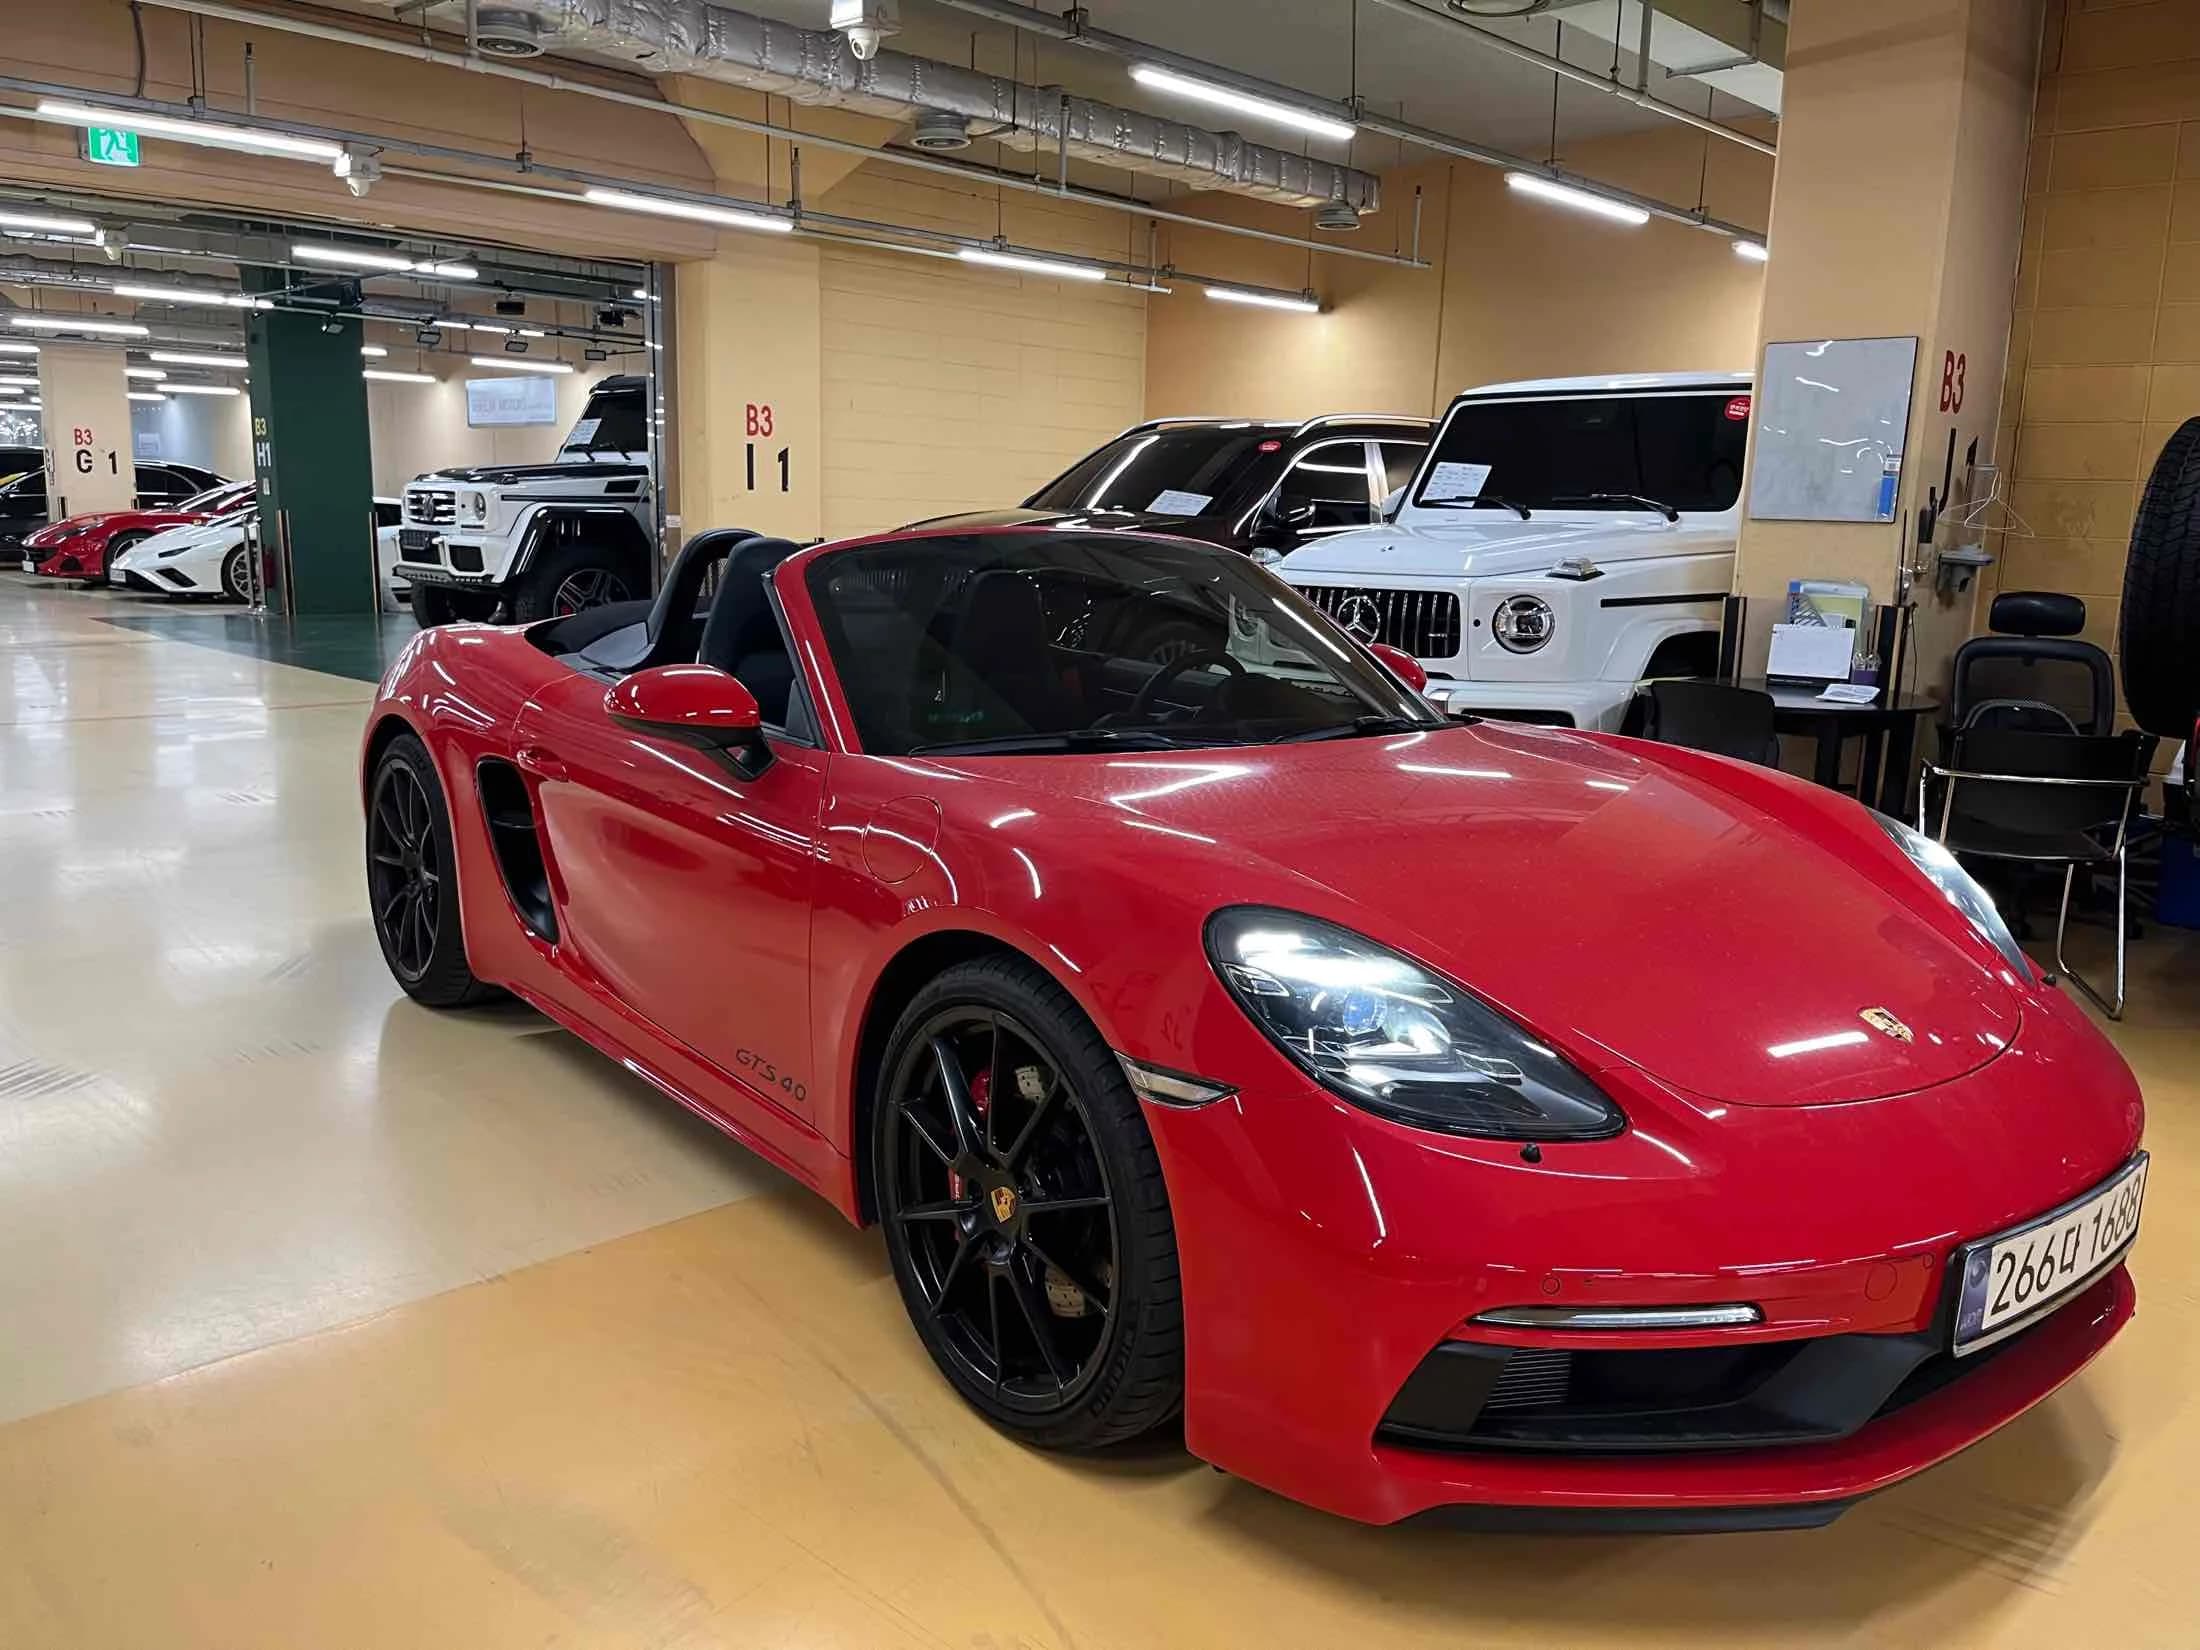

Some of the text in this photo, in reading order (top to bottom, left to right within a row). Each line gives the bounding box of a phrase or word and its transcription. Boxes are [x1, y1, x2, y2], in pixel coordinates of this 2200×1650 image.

[1939, 350, 1966, 414] B3
[74, 428, 93, 446] B3
[255, 417, 267, 436] B3
[746, 404, 773, 437] B3
[736, 1048, 776, 1082] GTS
[2090, 1172, 2141, 1263] 1688
